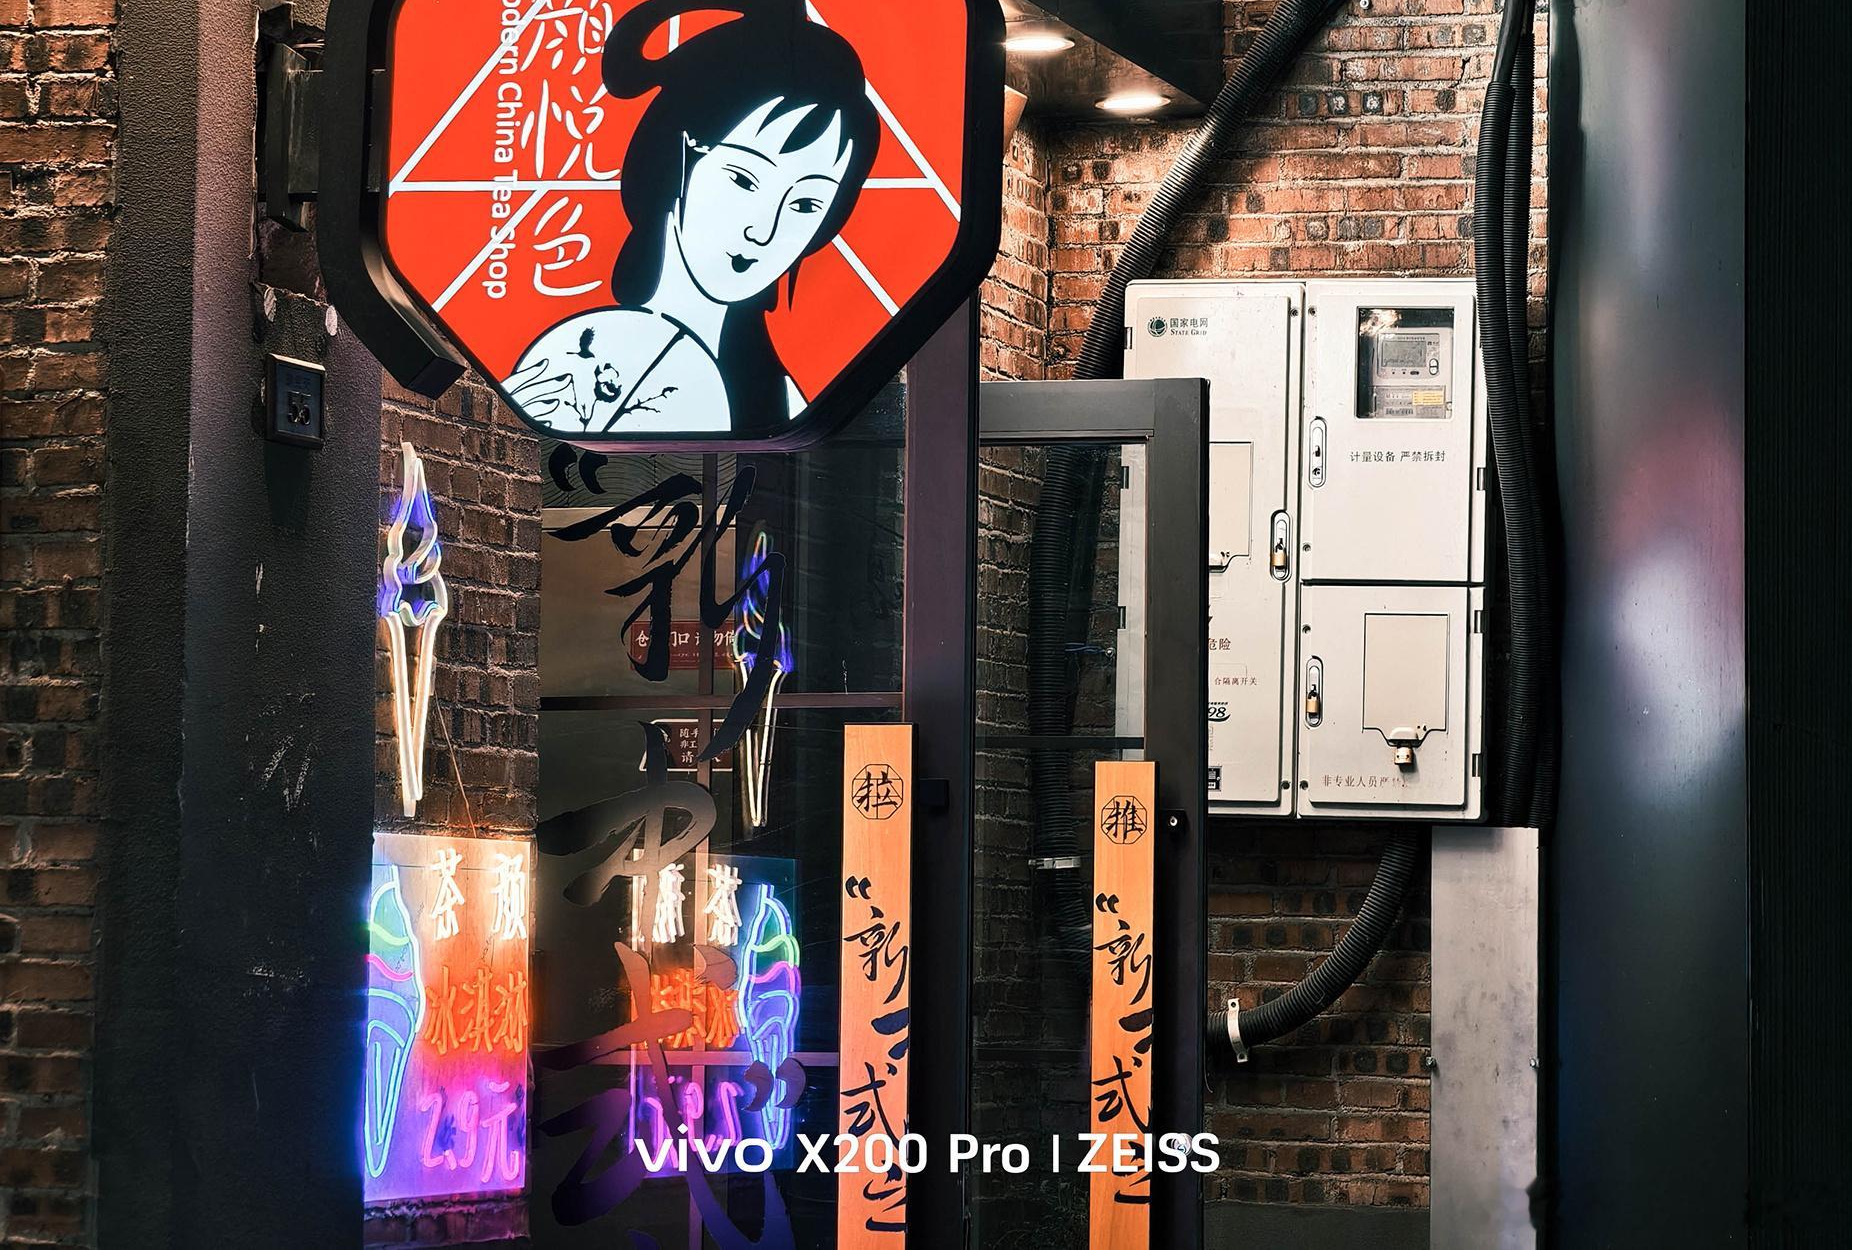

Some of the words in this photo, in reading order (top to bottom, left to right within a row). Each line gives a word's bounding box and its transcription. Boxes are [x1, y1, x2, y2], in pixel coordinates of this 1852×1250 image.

[494, 85, 523, 164] China
[490, 169, 518, 219] Tea
[482, 221, 516, 299] Shop
[1169, 317, 1209, 329] 国家电网
[1349, 450, 1396, 463] 计量设备
[1399, 450, 1446, 463] 严禁拆封
[1208, 637, 1232, 651] 危险
[856, 770, 899, 813] 拉
[1106, 799, 1144, 841] 推
[425, 967, 528, 1054] 冰淇淋
